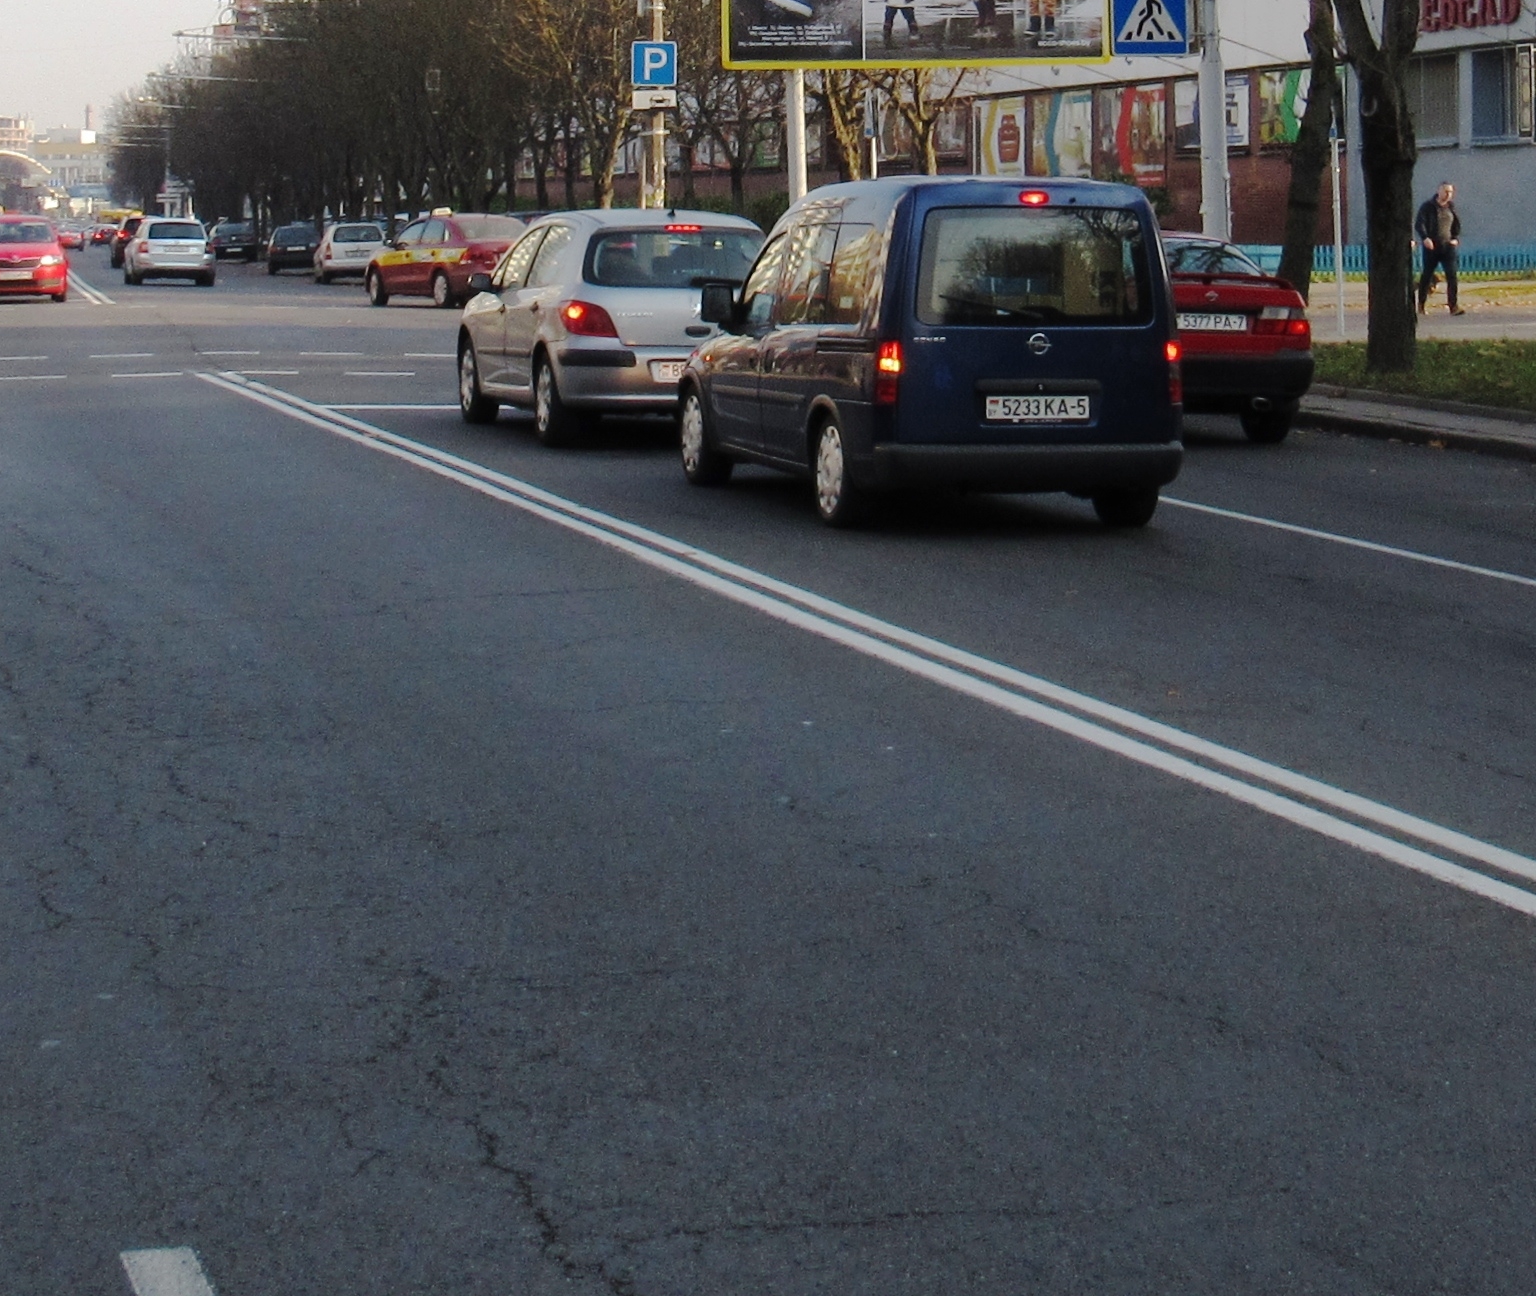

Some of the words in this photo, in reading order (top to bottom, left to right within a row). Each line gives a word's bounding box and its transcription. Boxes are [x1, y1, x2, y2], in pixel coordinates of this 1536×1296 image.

[643, 47, 668, 81] P
[1183, 314, 1211, 328] 5377
[1213, 315, 1244, 329] PA-7
[1002, 398, 1041, 416] 5233
[1044, 398, 1086, 416] KA-5
